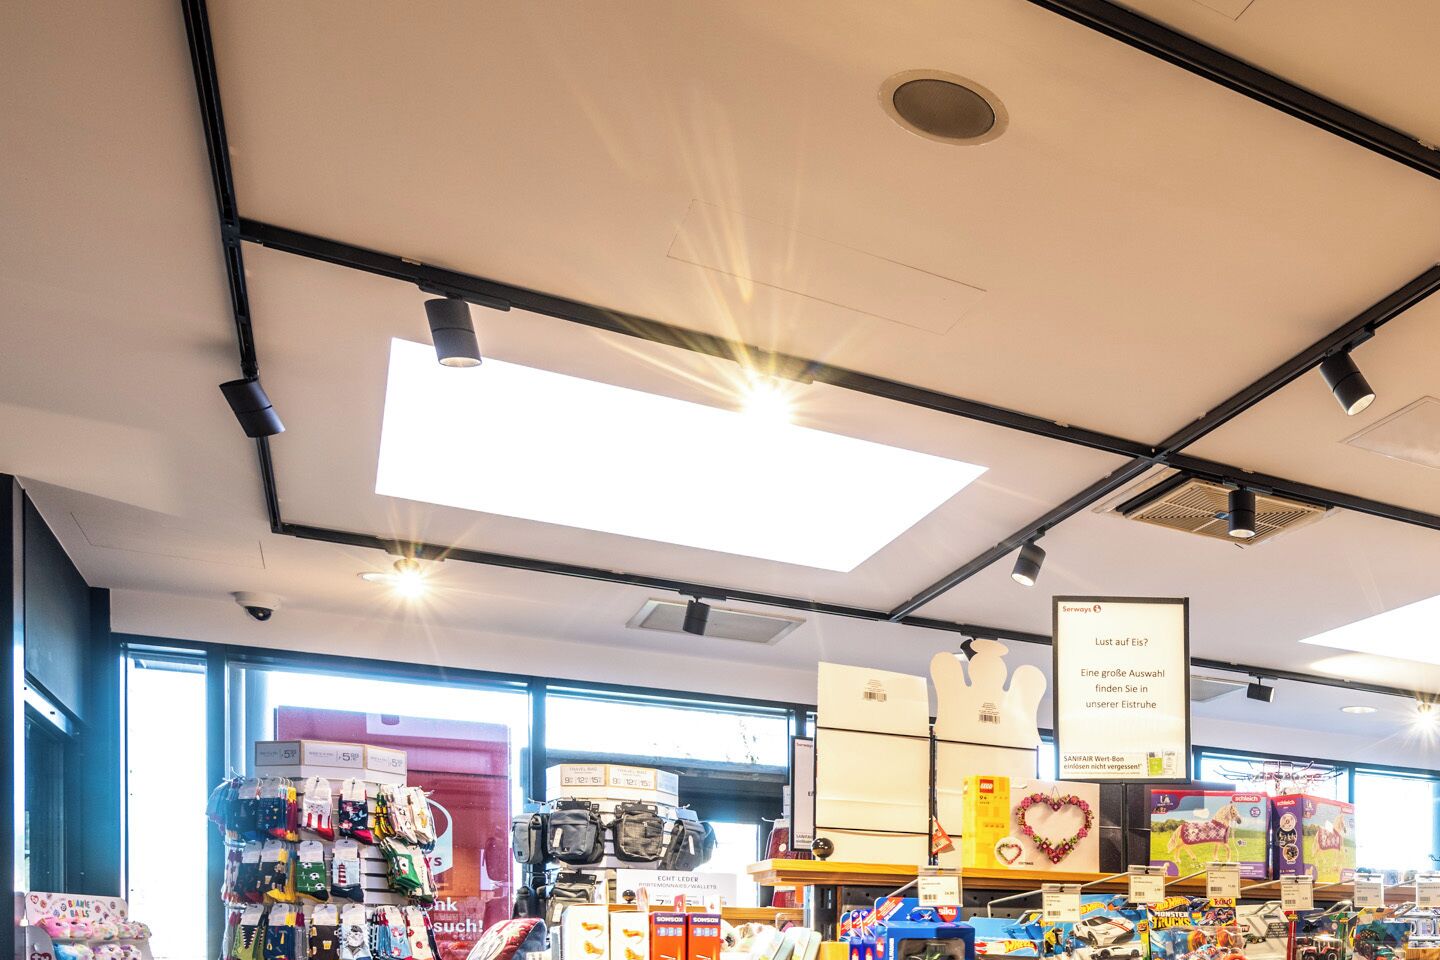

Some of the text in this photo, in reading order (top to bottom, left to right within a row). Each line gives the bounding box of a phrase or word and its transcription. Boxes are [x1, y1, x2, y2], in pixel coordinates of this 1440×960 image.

[1062, 605, 1092, 613] Serways
[1095, 637, 1149, 647] Lust auf Eis?
[1080, 668, 1165, 679] Eine große Auswahl
[1095, 684, 1148, 693] finden Sie in
[1086, 700, 1157, 709] unserer Eistruhe
[1107, 763, 1140, 771] vergessen!
[1235, 795, 1259, 803] schleich
[938, 907, 957, 916] siku
[1151, 917, 1192, 929] TRUCKS
